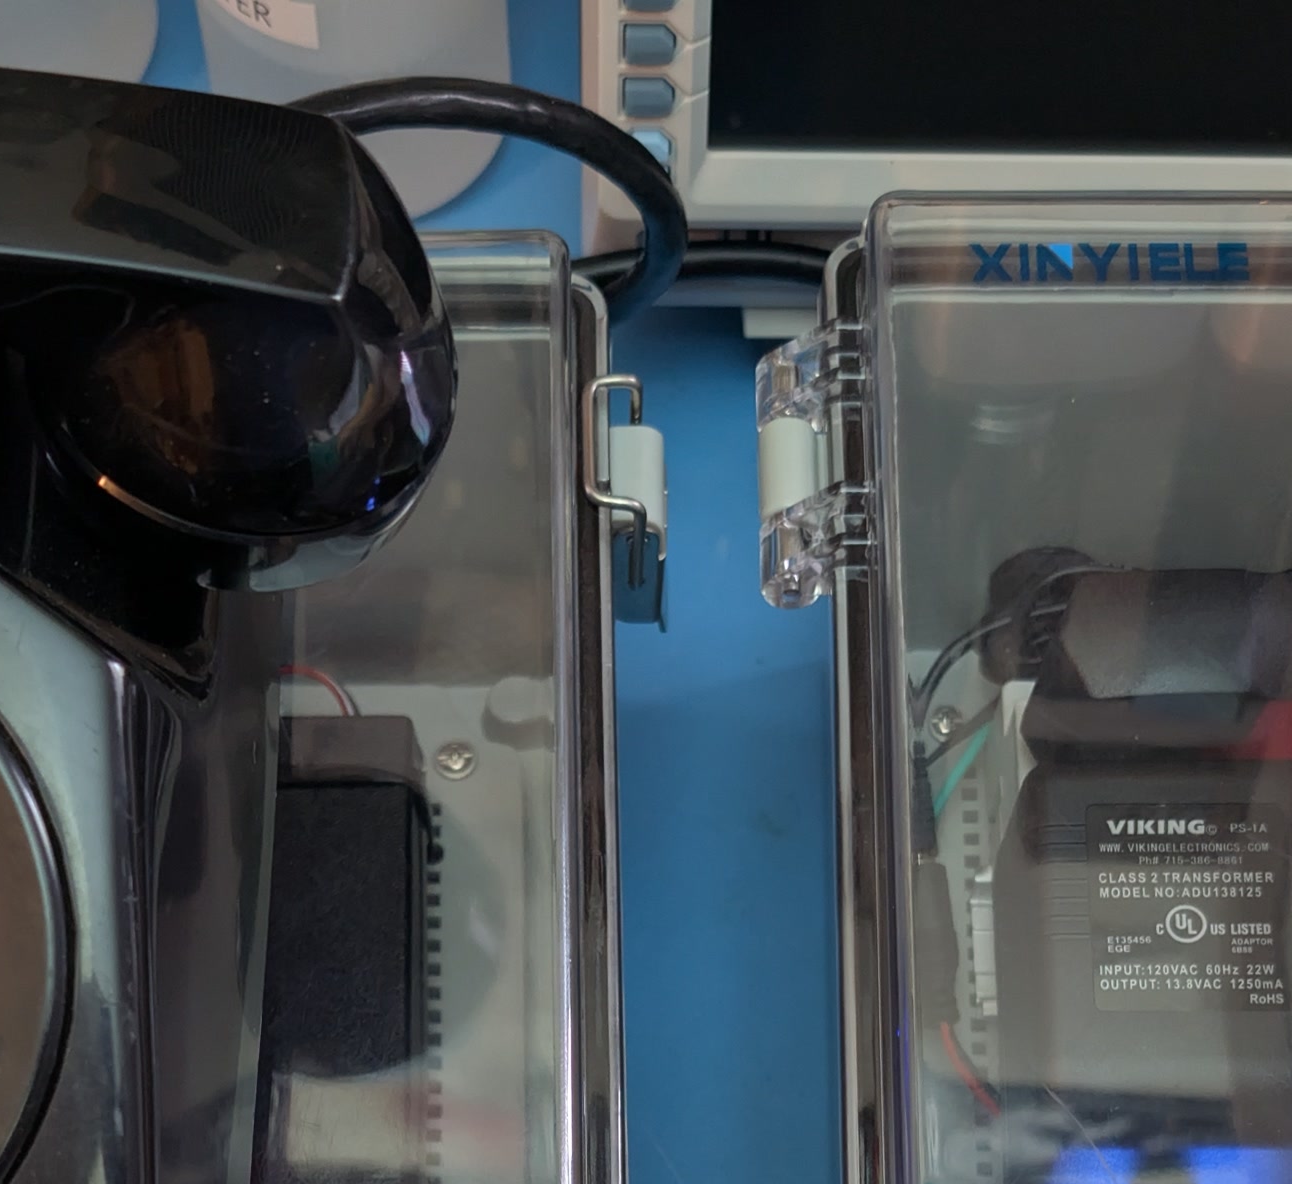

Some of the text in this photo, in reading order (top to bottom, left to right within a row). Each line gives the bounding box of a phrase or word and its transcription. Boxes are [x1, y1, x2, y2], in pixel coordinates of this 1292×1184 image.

[969, 242, 1251, 282] XINYIELE
[1229, 822, 1268, 834] PS-1A
[1138, 855, 1159, 866] Ph#
[1098, 871, 1275, 885] CLASS 2 TRANSFORMER
[1099, 887, 1151, 899] MODEL
[1210, 923, 1227, 936] US
[1230, 923, 1272, 936] LISTED
[1107, 935, 1152, 945] E135456
[1230, 937, 1274, 946] ADAPTOR
[1108, 944, 1131, 954] EGE
[1205, 965, 1240, 976] 60Hz
[1246, 965, 1276, 976] 22W
[1099, 979, 1285, 992] OUTPUT: 13.8VAC 1250mA
[1249, 993, 1285, 1006] RoHS
